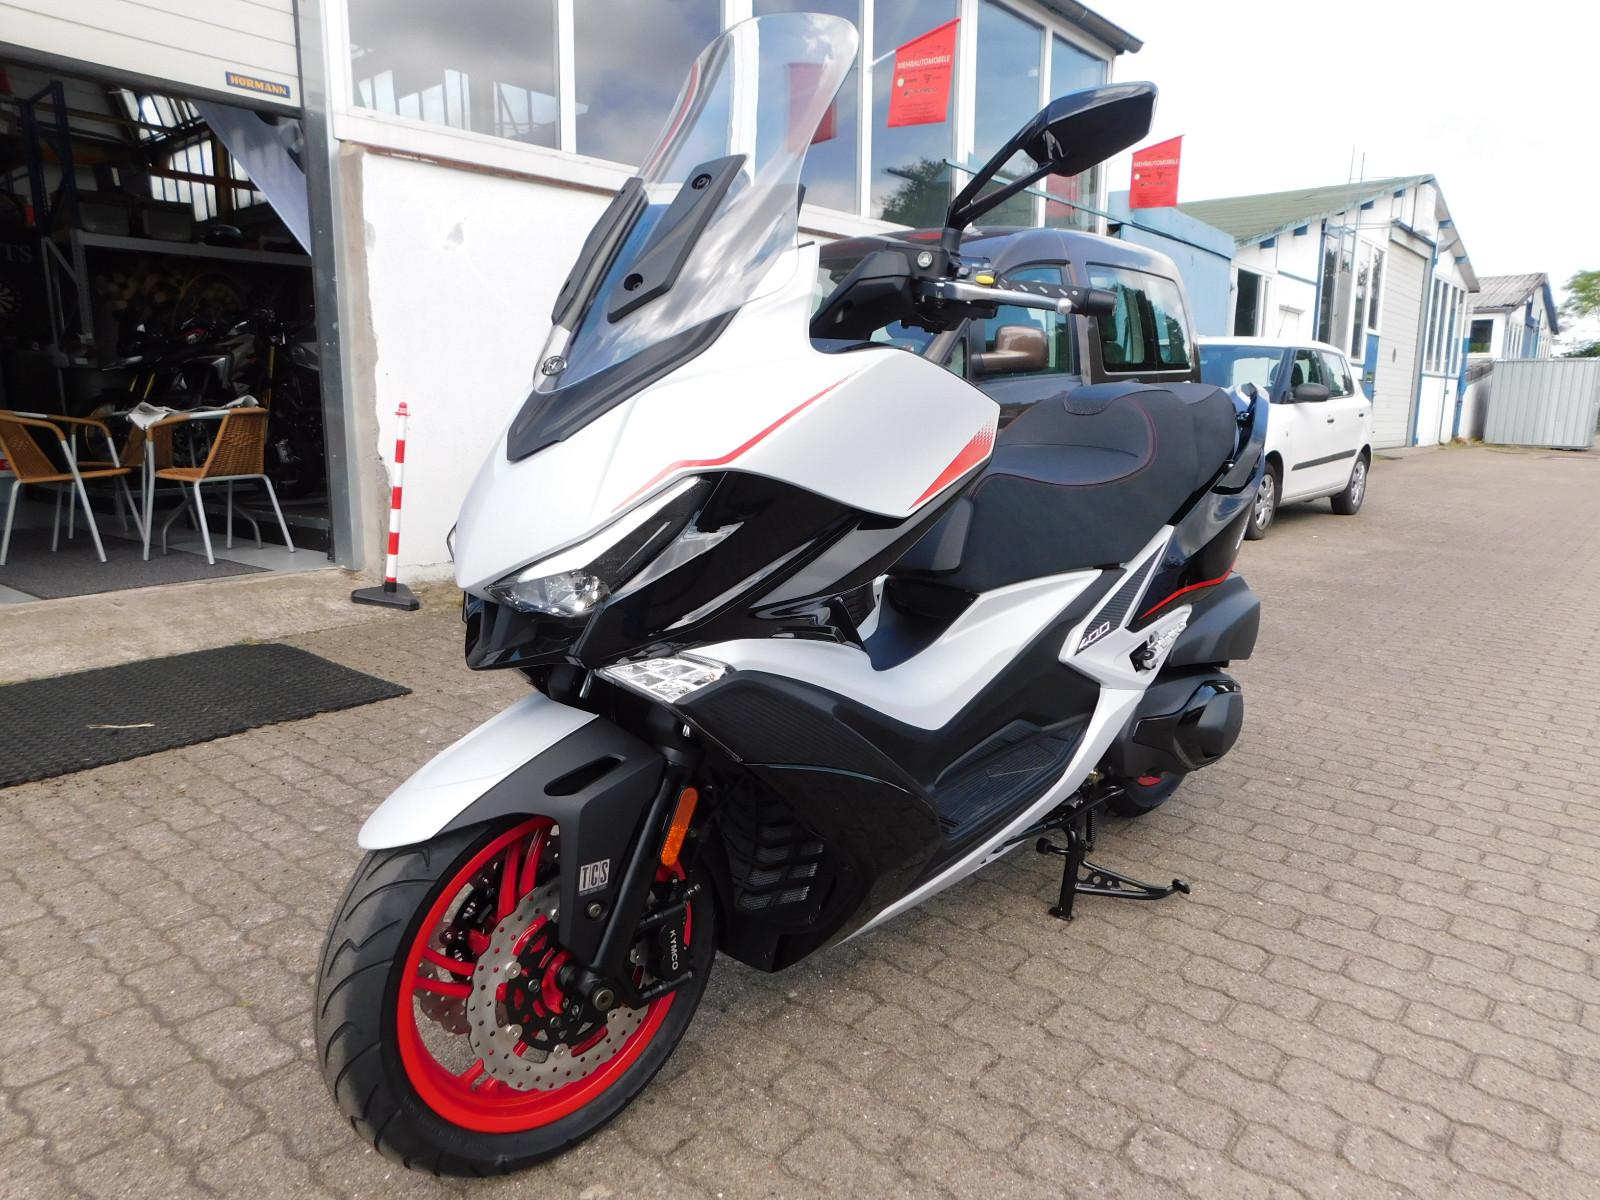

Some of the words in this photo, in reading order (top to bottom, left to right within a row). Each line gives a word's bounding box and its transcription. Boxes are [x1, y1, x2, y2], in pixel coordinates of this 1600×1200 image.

[1079, 621, 1110, 650] 400
[581, 860, 609, 890] TCS
[669, 929, 679, 971] KYMCO
